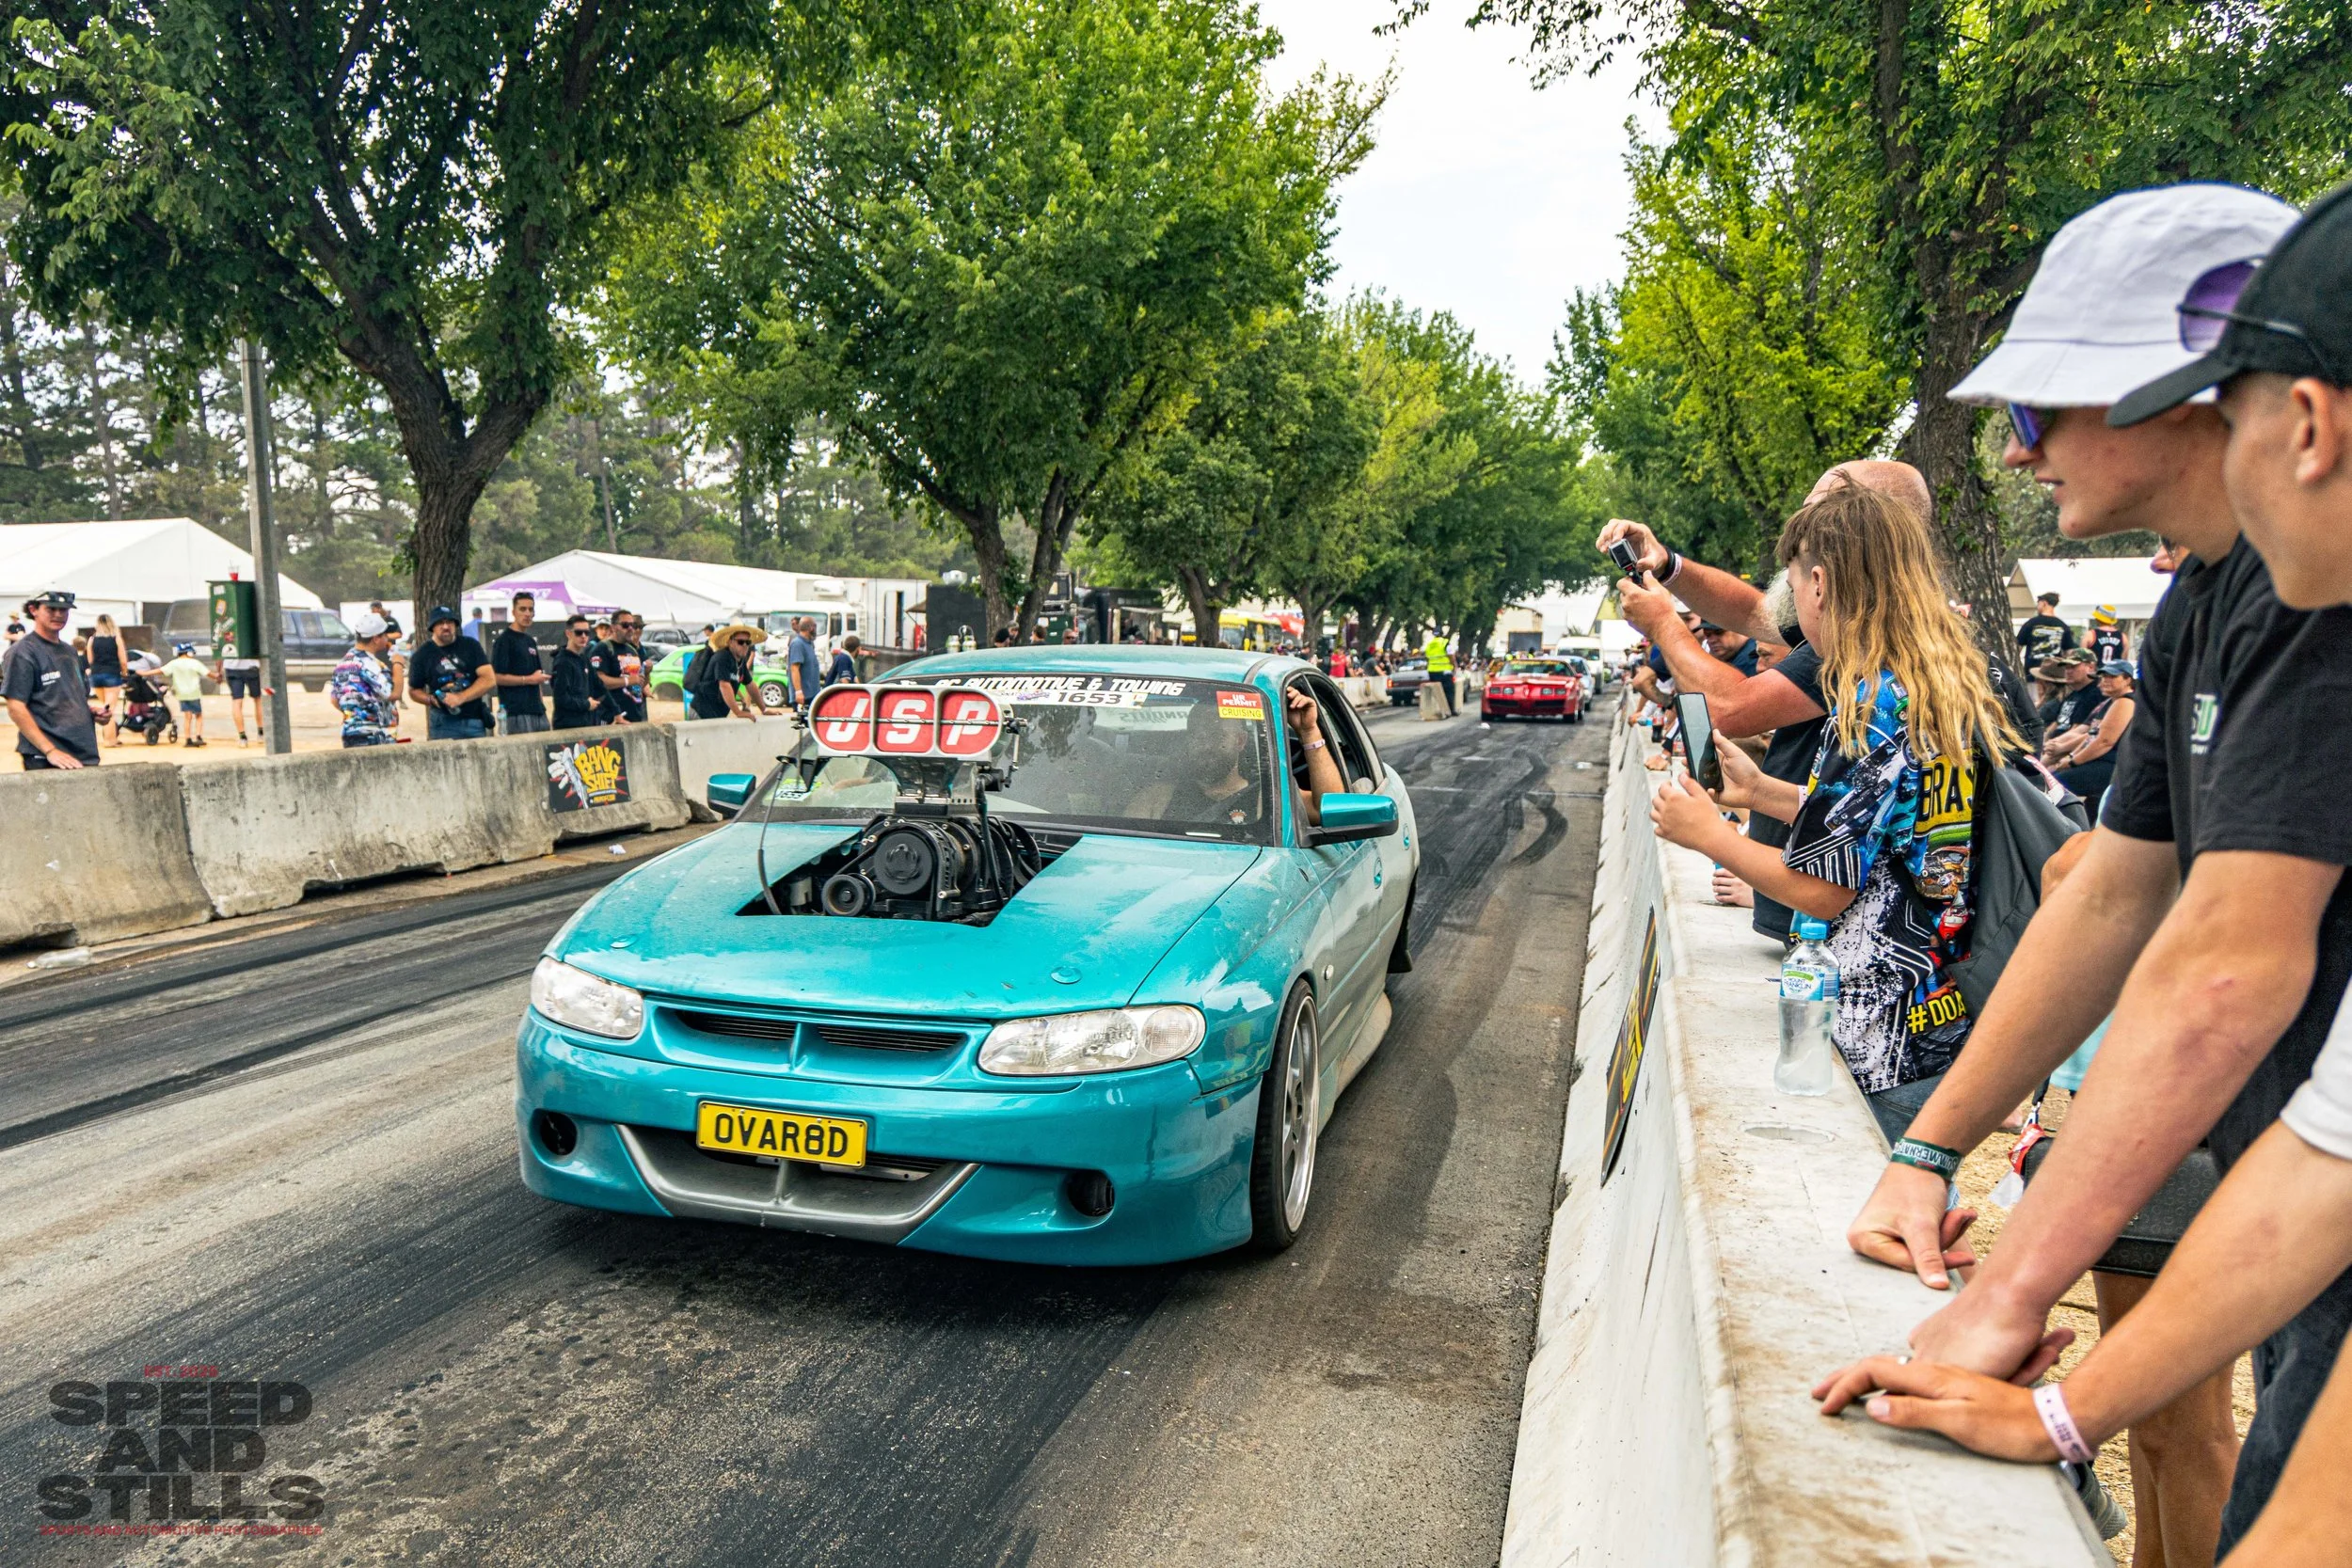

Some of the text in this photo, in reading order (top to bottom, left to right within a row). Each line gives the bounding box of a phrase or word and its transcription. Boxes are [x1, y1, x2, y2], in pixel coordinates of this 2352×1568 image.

[962, 677, 1087, 691] AUTOMOTIVE
[1087, 678, 1103, 690] &
[1111, 678, 1186, 696] TOWING
[1057, 691, 1122, 705] 1653
[1222, 708, 1262, 718] CRUISING
[575, 745, 622, 778] BANG
[582, 771, 618, 794] SHIFT
[715, 1113, 849, 1158] OVAR8D
